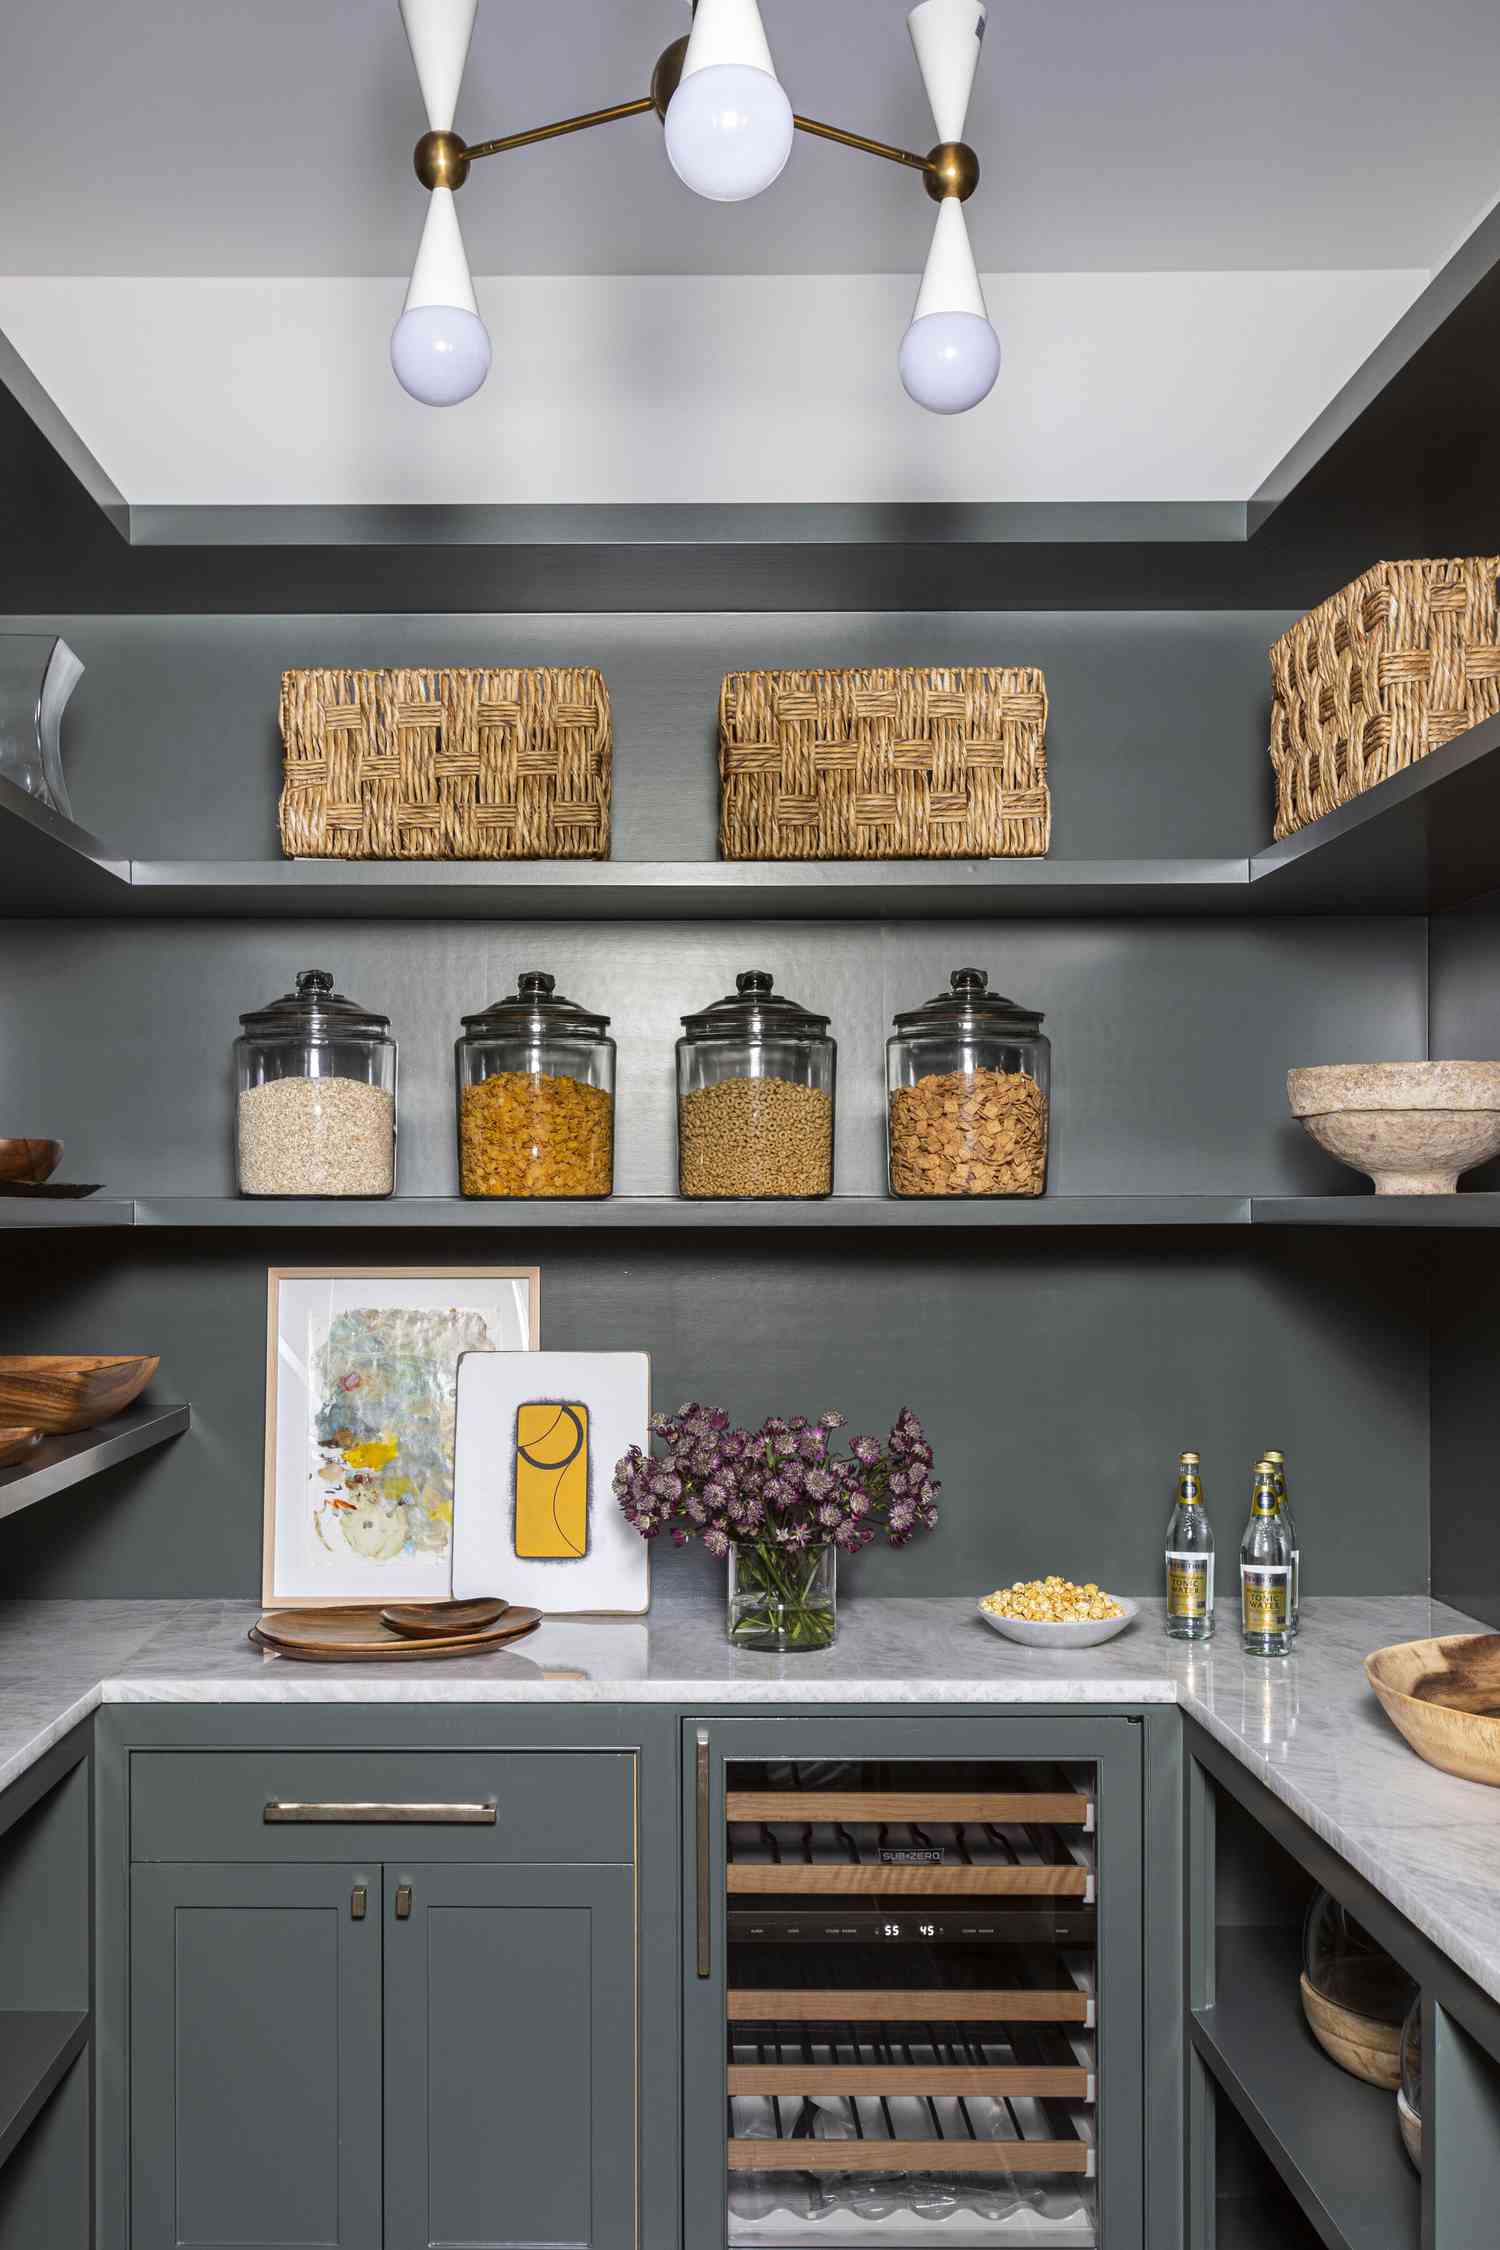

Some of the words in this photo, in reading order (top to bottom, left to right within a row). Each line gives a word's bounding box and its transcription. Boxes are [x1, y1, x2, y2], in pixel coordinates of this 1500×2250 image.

[1172, 1579, 1200, 1587] TONIC
[1251, 1593, 1280, 1601] TONIC
[1249, 1601, 1280, 1609] WATER
[919, 1925, 934, 1936] 45
